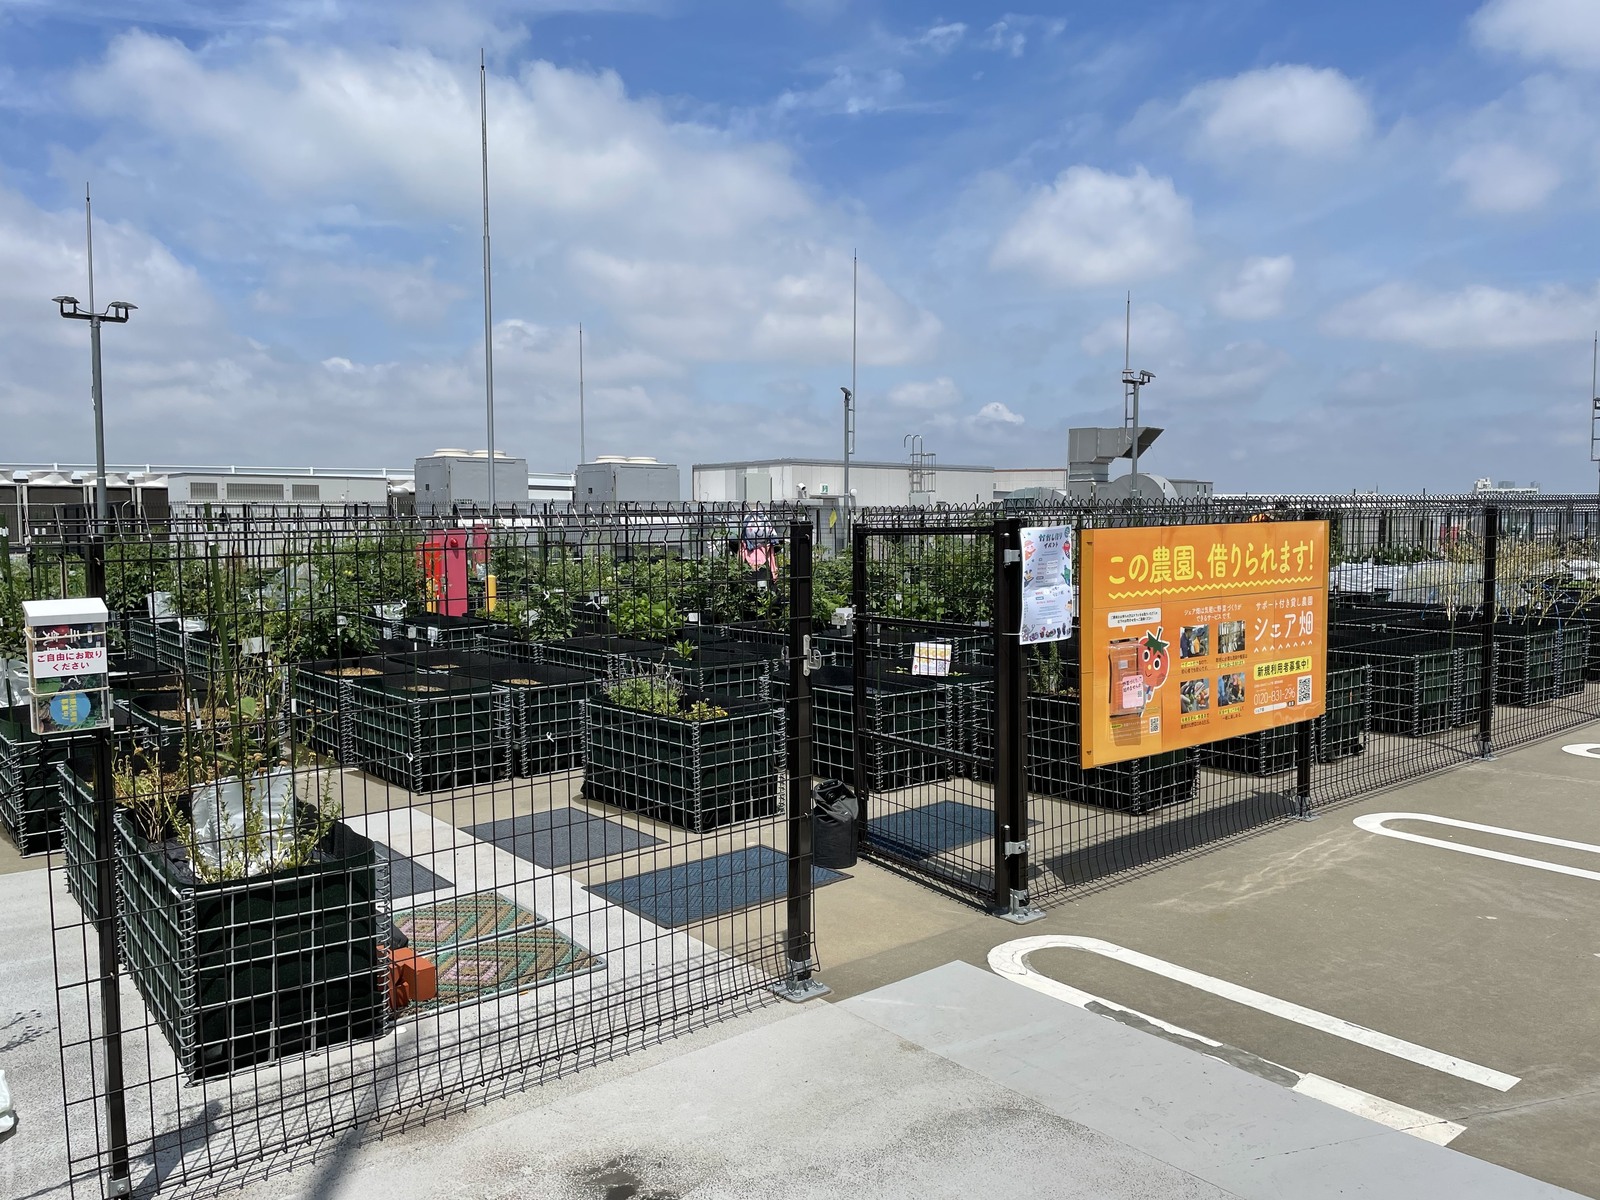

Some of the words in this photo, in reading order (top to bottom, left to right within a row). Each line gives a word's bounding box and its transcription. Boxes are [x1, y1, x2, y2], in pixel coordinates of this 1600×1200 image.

[1108, 540, 1314, 585] この農園、借りられます!
[1255, 596, 1313, 611] サポート付き貸し農園
[1254, 610, 1314, 641] シェア畑
[37, 650, 104, 663] ご自由にお取り
[52, 661, 90, 671] ください
[1257, 659, 1310, 677] 新規利用者募集中!
[1254, 687, 1296, 705] 0120-831-296
